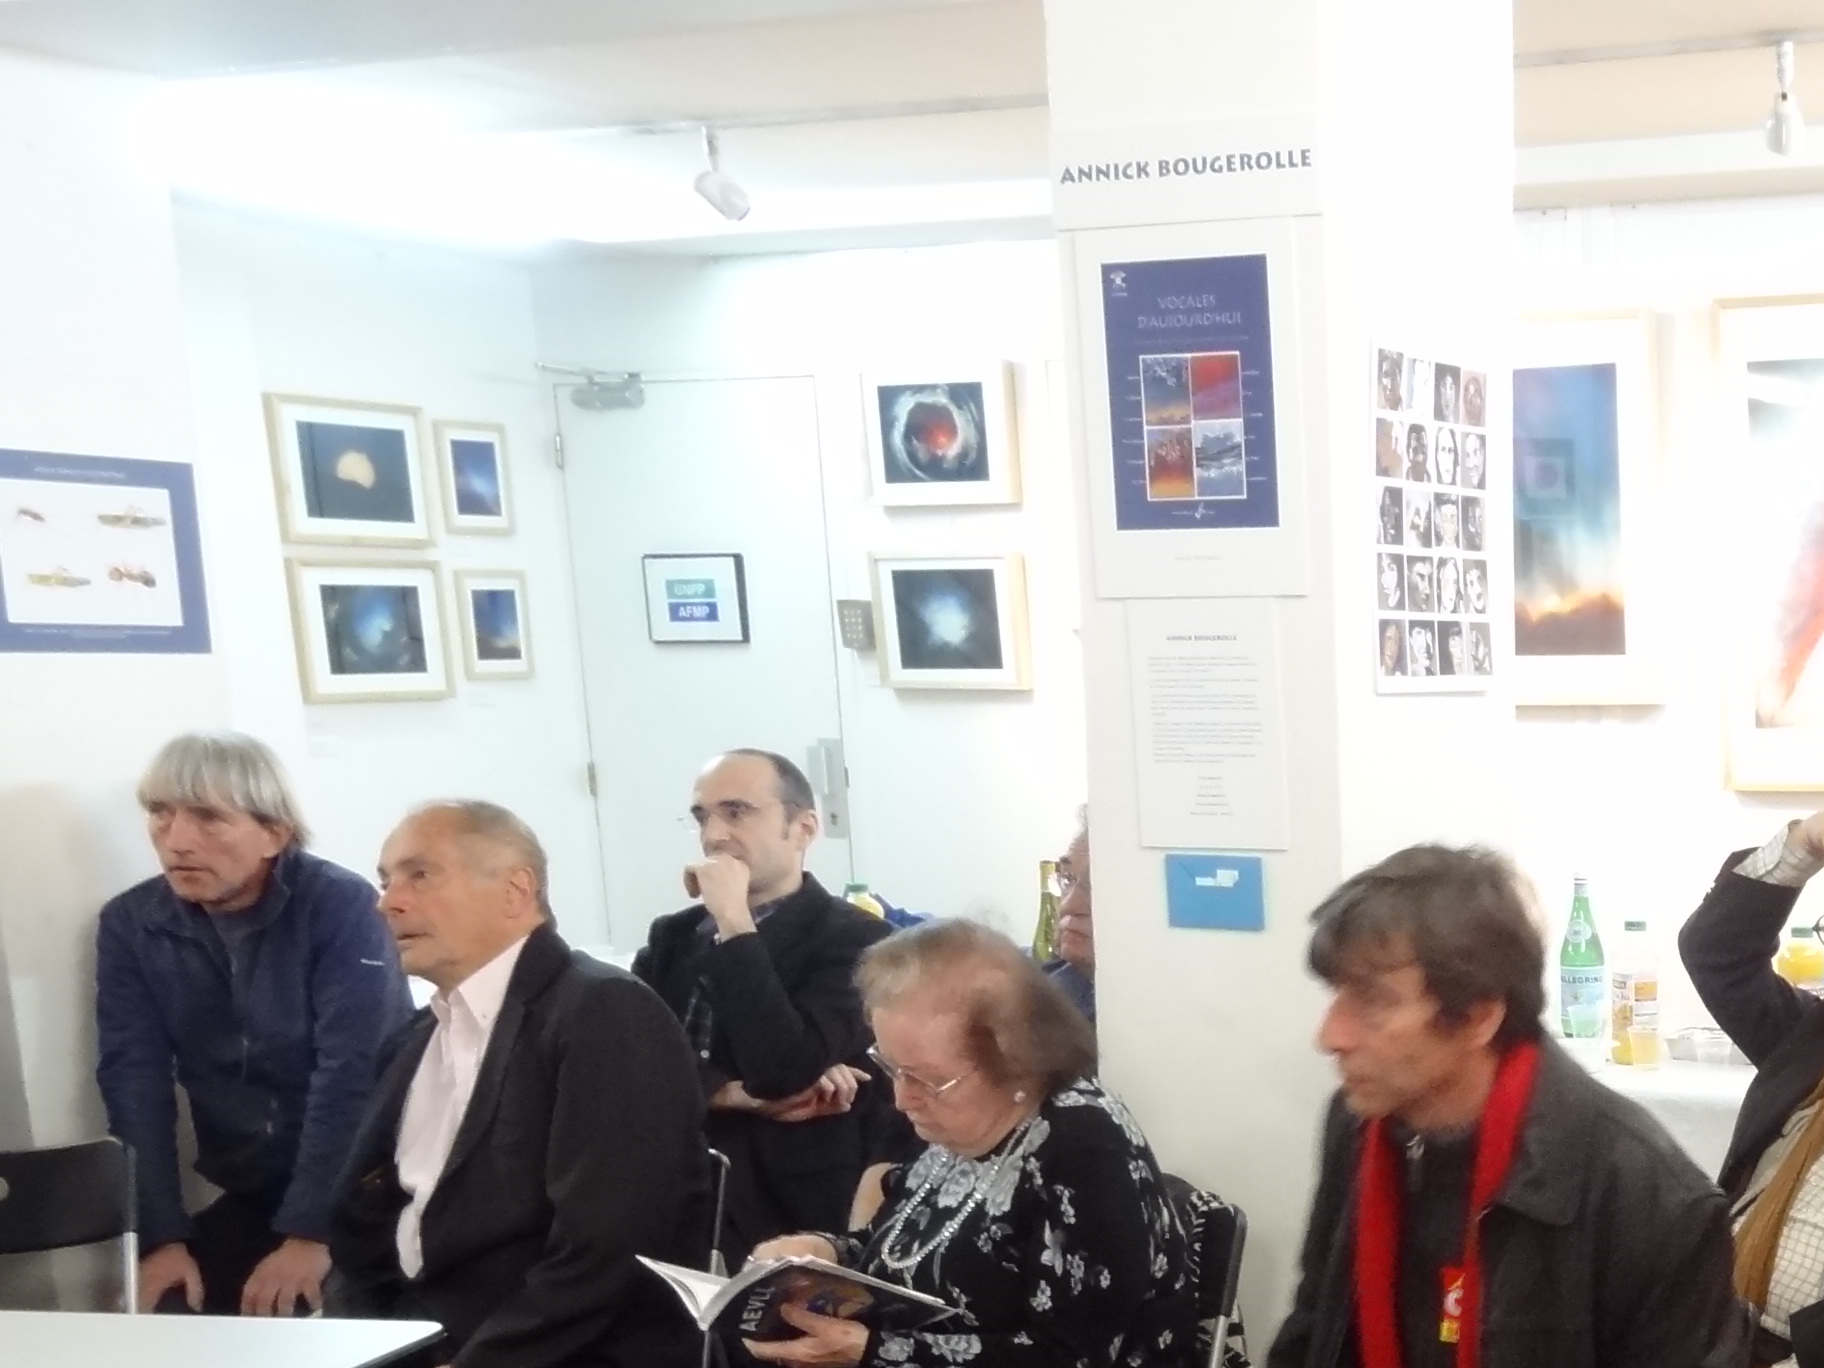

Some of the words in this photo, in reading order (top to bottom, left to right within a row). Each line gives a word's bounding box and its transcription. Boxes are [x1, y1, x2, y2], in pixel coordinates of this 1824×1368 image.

[1060, 160, 1150, 185] ANNICK
[1158, 148, 1312, 178] BOUGEROLLE
[1157, 293, 1216, 309] VOCALES
